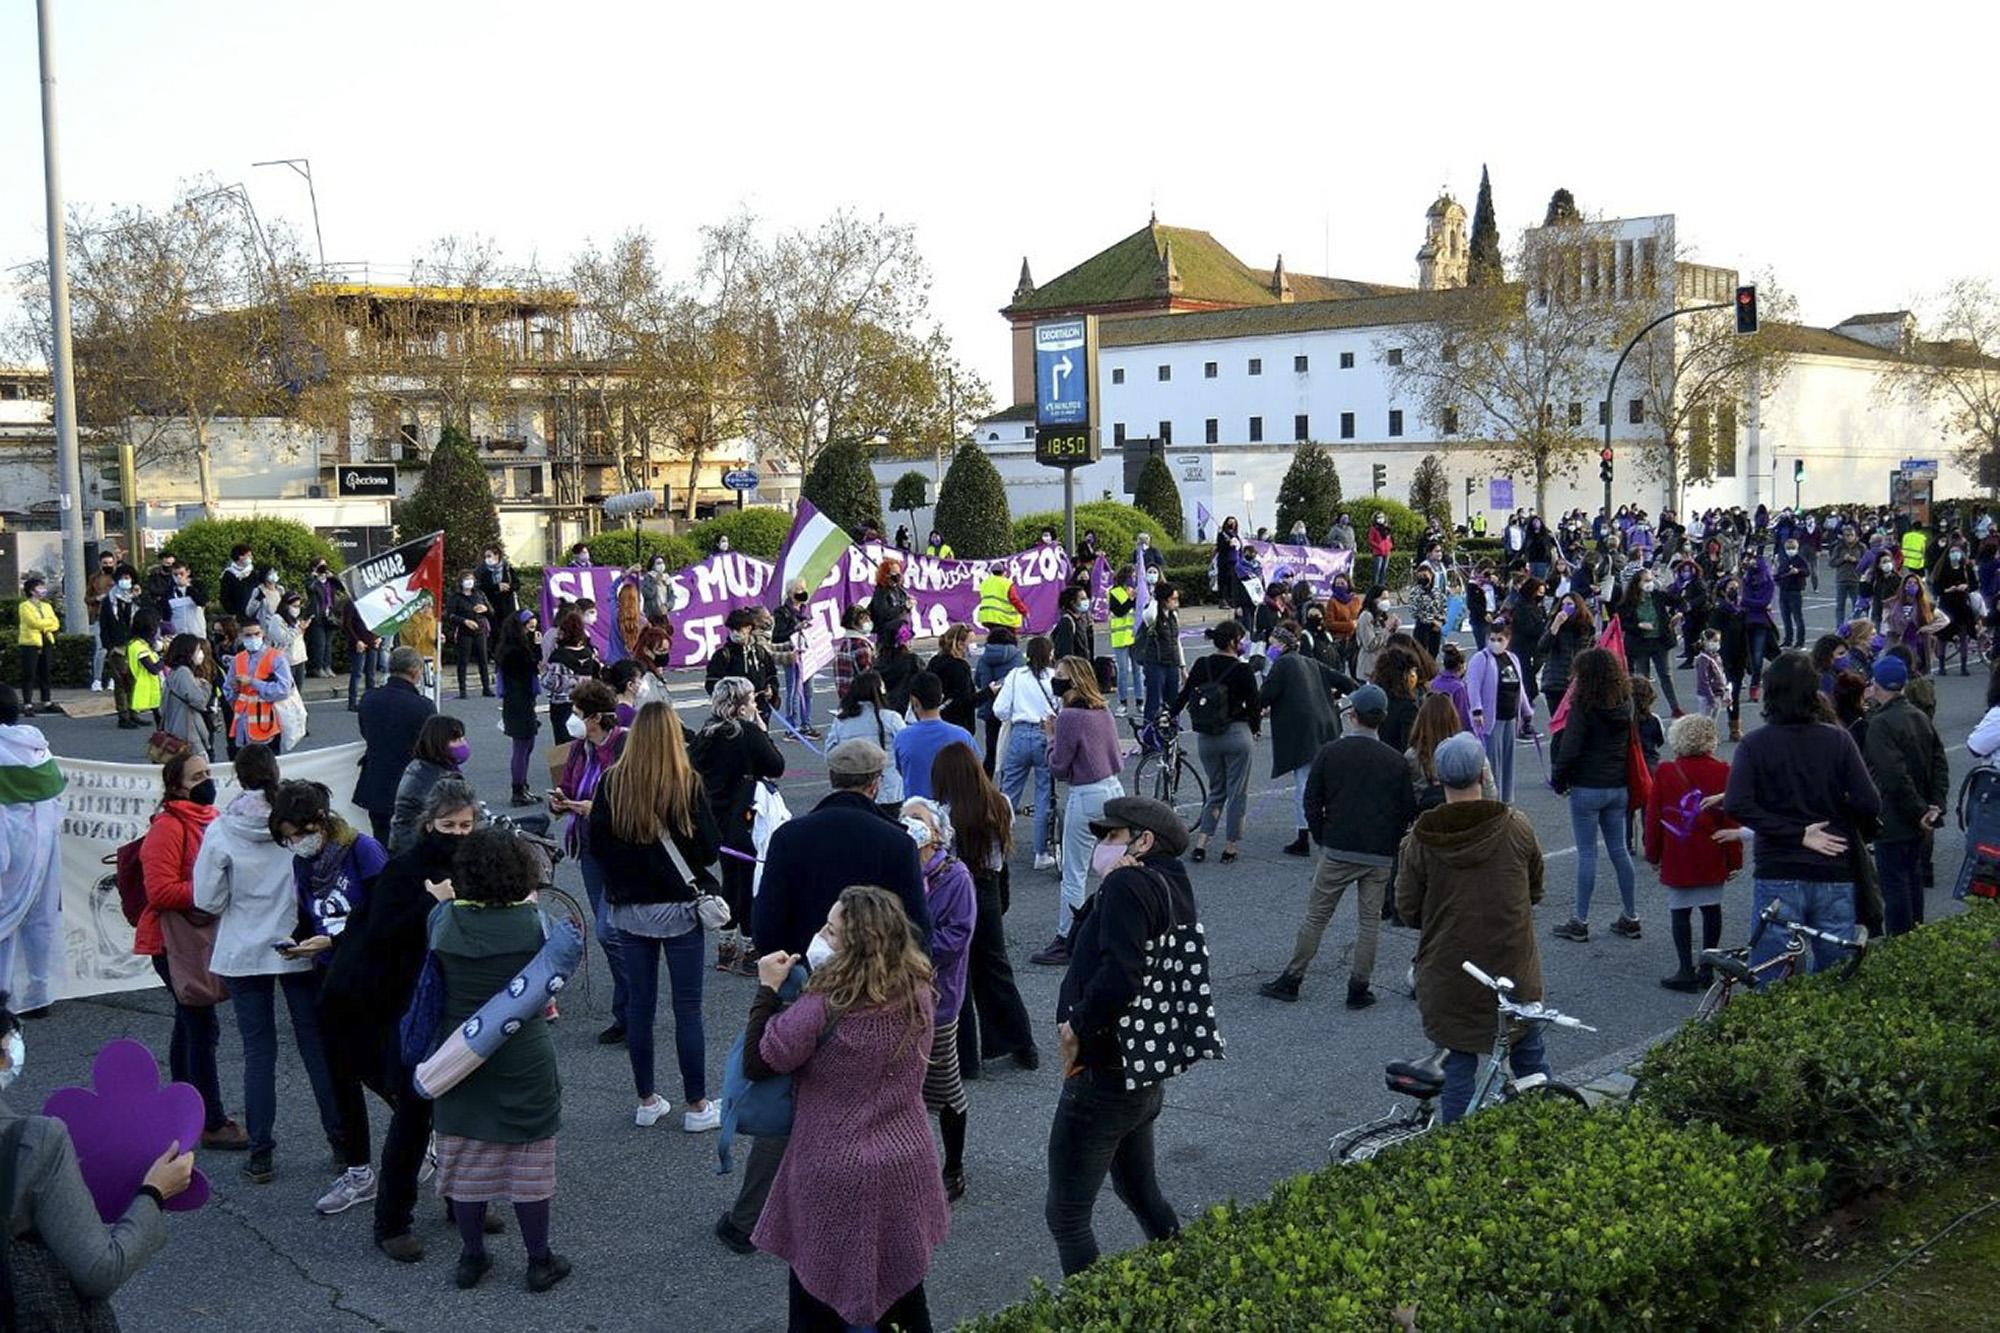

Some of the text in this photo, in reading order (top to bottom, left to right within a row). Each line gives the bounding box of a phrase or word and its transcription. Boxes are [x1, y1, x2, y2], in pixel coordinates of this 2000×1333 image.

[1041, 328, 1080, 341] DECATHLON
[1047, 437, 1085, 455] 18:50
[549, 571, 596, 604] SI
[972, 546, 1067, 592] BAZOS
